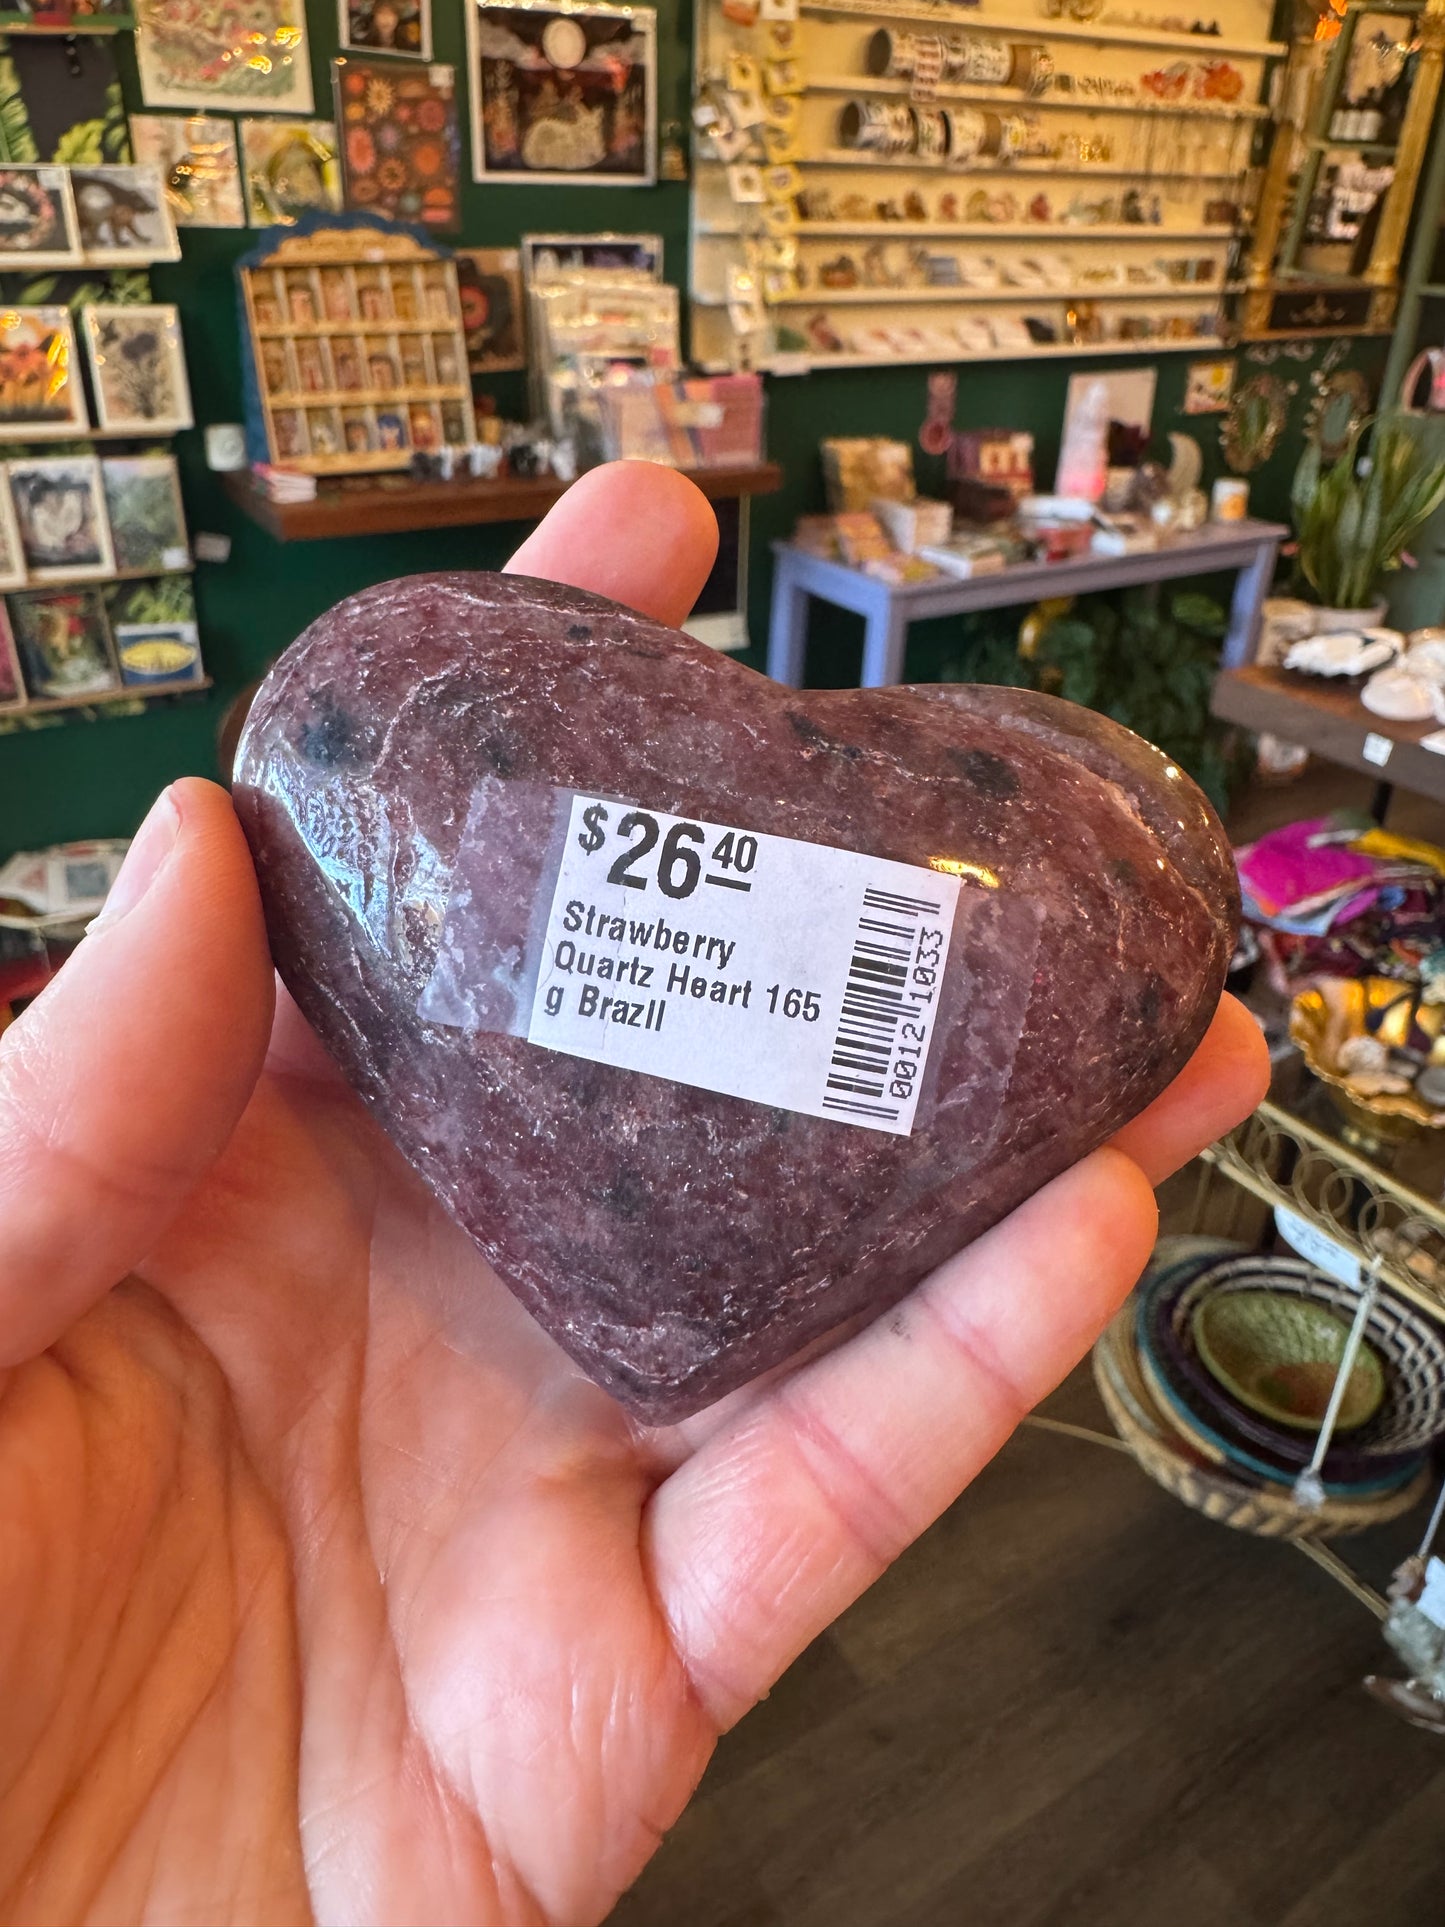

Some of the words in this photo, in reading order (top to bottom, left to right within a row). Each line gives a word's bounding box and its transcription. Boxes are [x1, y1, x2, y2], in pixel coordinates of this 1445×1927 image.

[562, 900, 736, 970] Strawberry
[543, 985, 565, 1017] g
[554, 940, 655, 988] Quartz
[666, 962, 752, 1009] Heart
[766, 984, 822, 1022] 165
